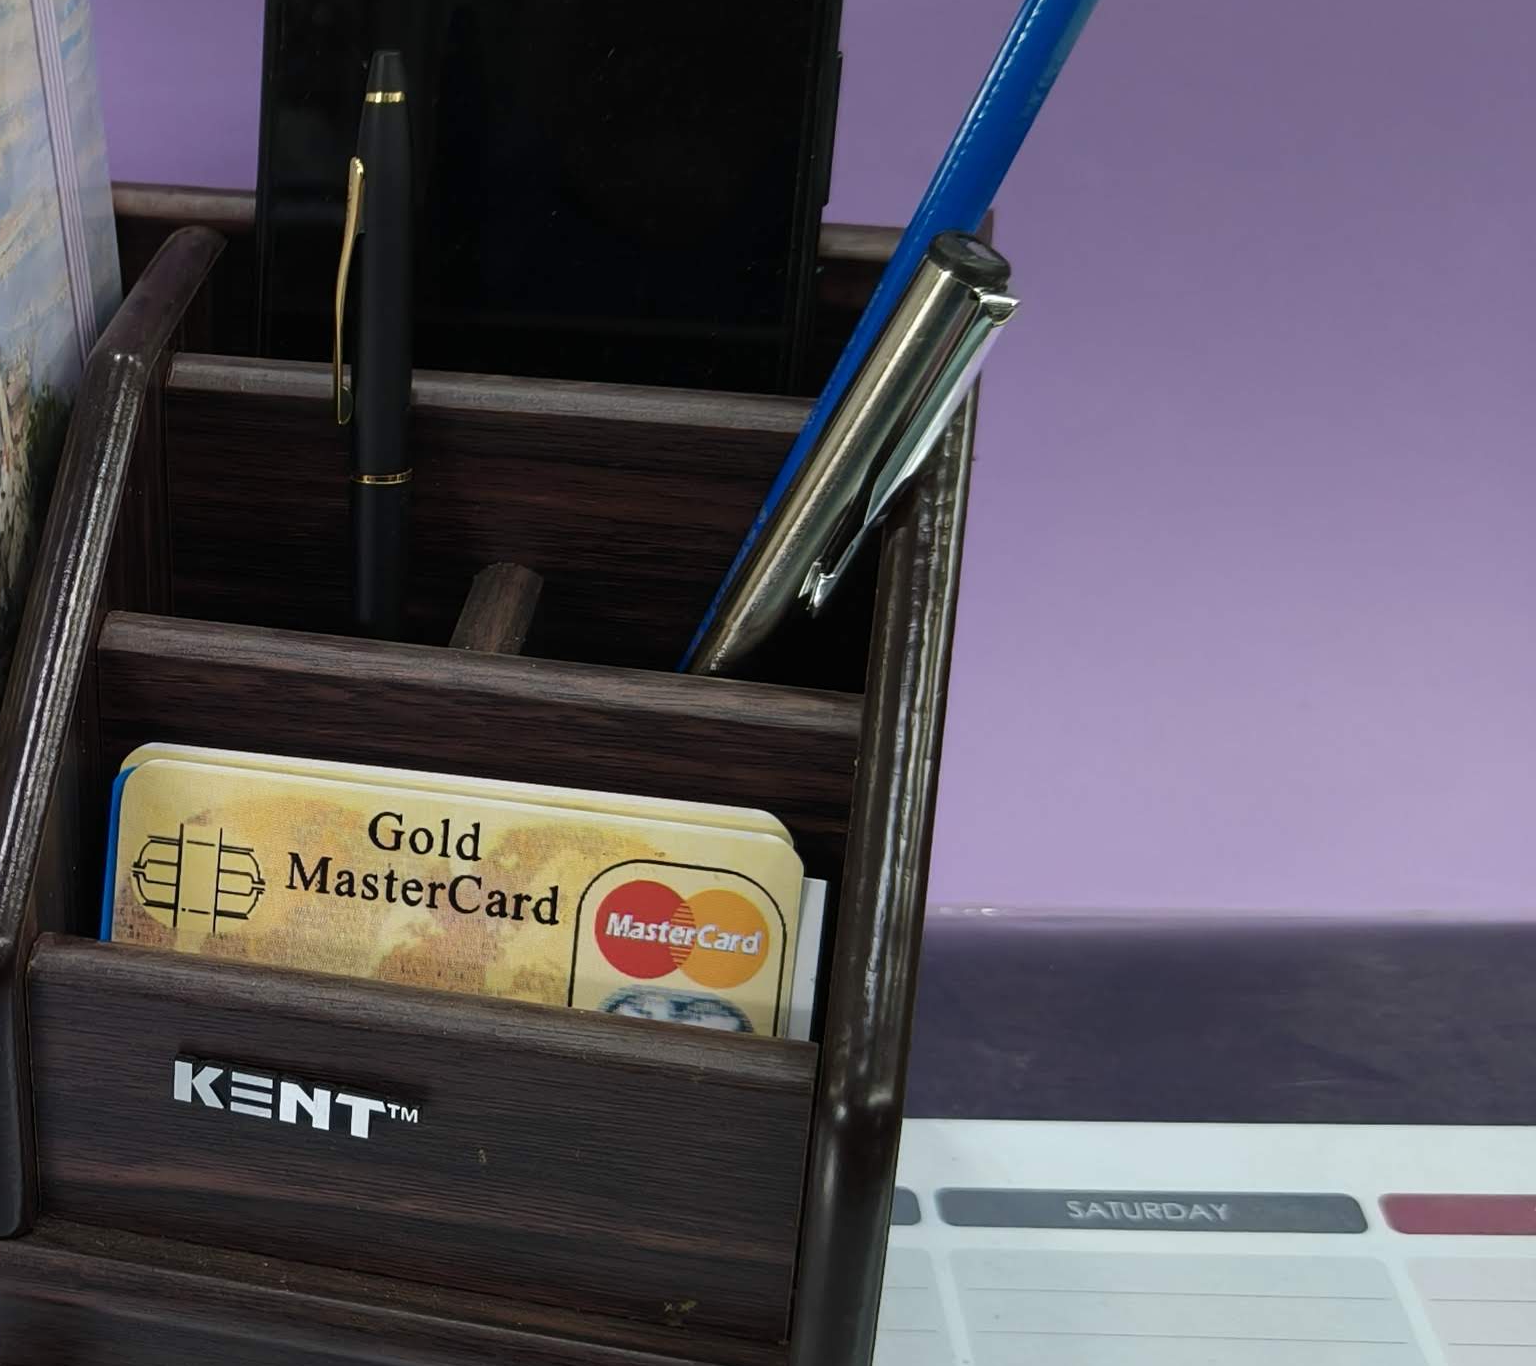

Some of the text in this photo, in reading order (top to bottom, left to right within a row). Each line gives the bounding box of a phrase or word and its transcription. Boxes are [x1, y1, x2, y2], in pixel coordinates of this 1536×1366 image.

[367, 811, 482, 862] Gold
[285, 851, 560, 926] MasterCard
[605, 912, 763, 956] MasterCard
[173, 1060, 387, 1139] KENT
[1065, 1200, 1229, 1222] SATURDAY
